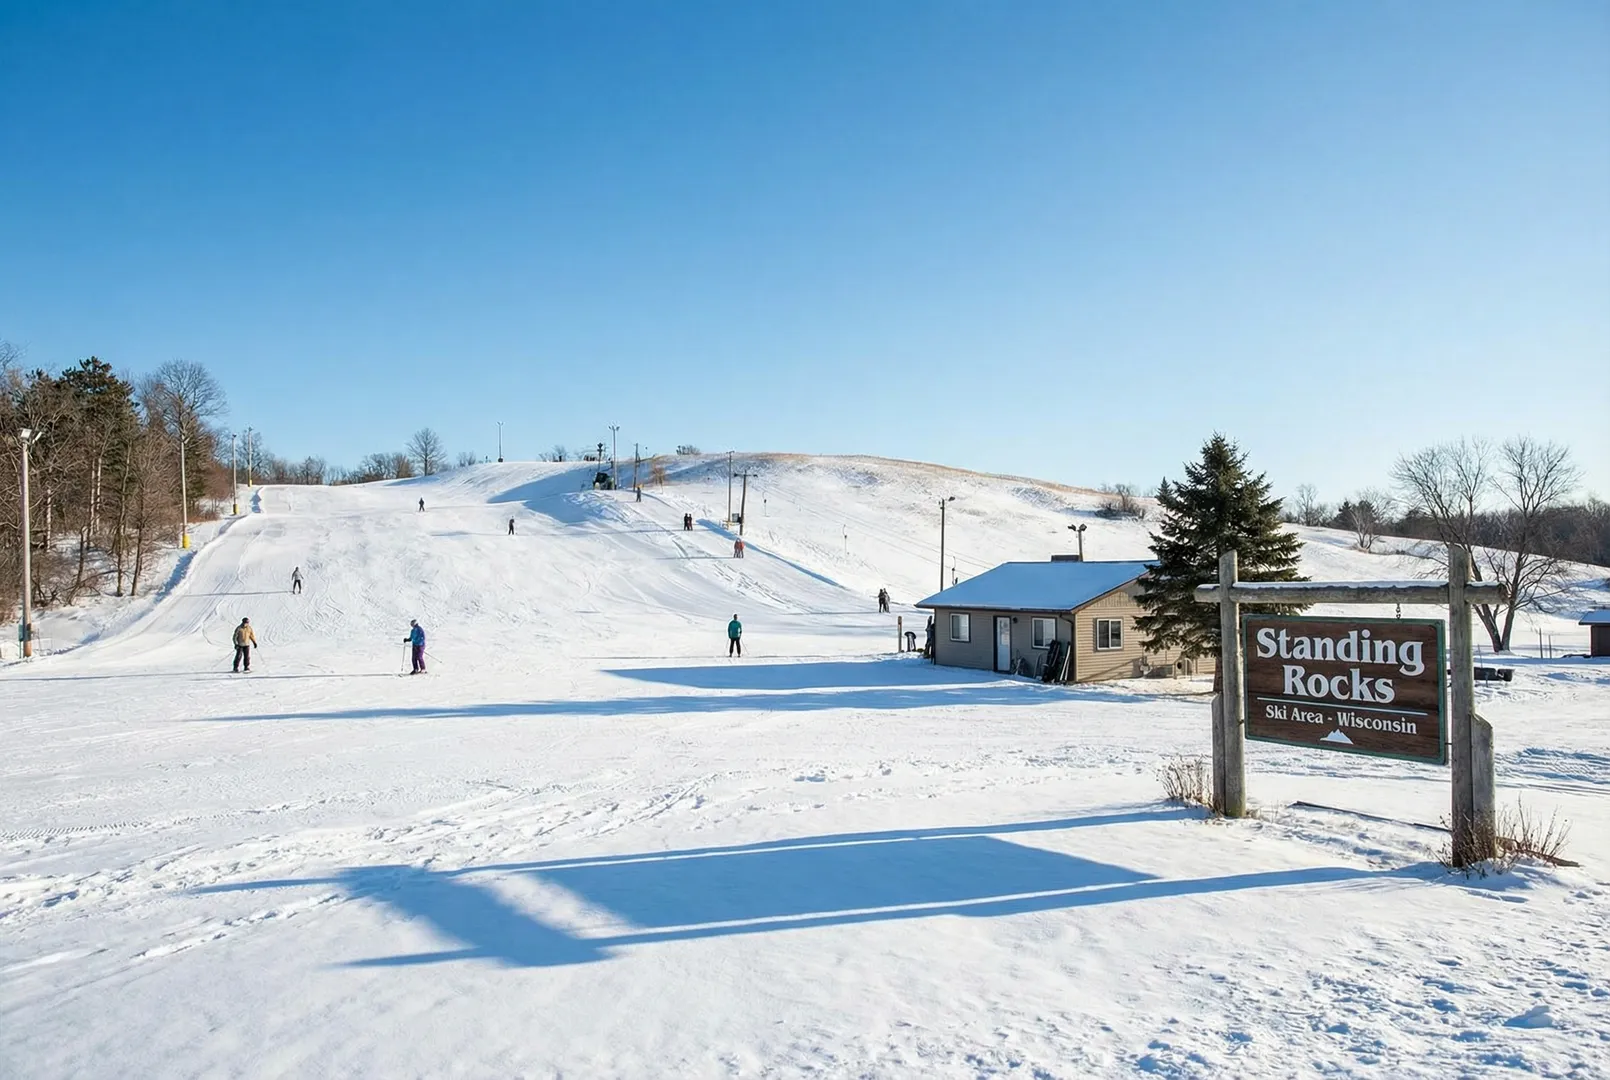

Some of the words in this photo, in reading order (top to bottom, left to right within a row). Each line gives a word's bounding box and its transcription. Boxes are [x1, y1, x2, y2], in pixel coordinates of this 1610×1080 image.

[1256, 627, 1425, 677] Standing
[1282, 664, 1396, 704] Rocks
[1265, 705, 1288, 720] Ski
[1291, 707, 1324, 724] Area
[1337, 711, 1417, 735] Wisconsin
